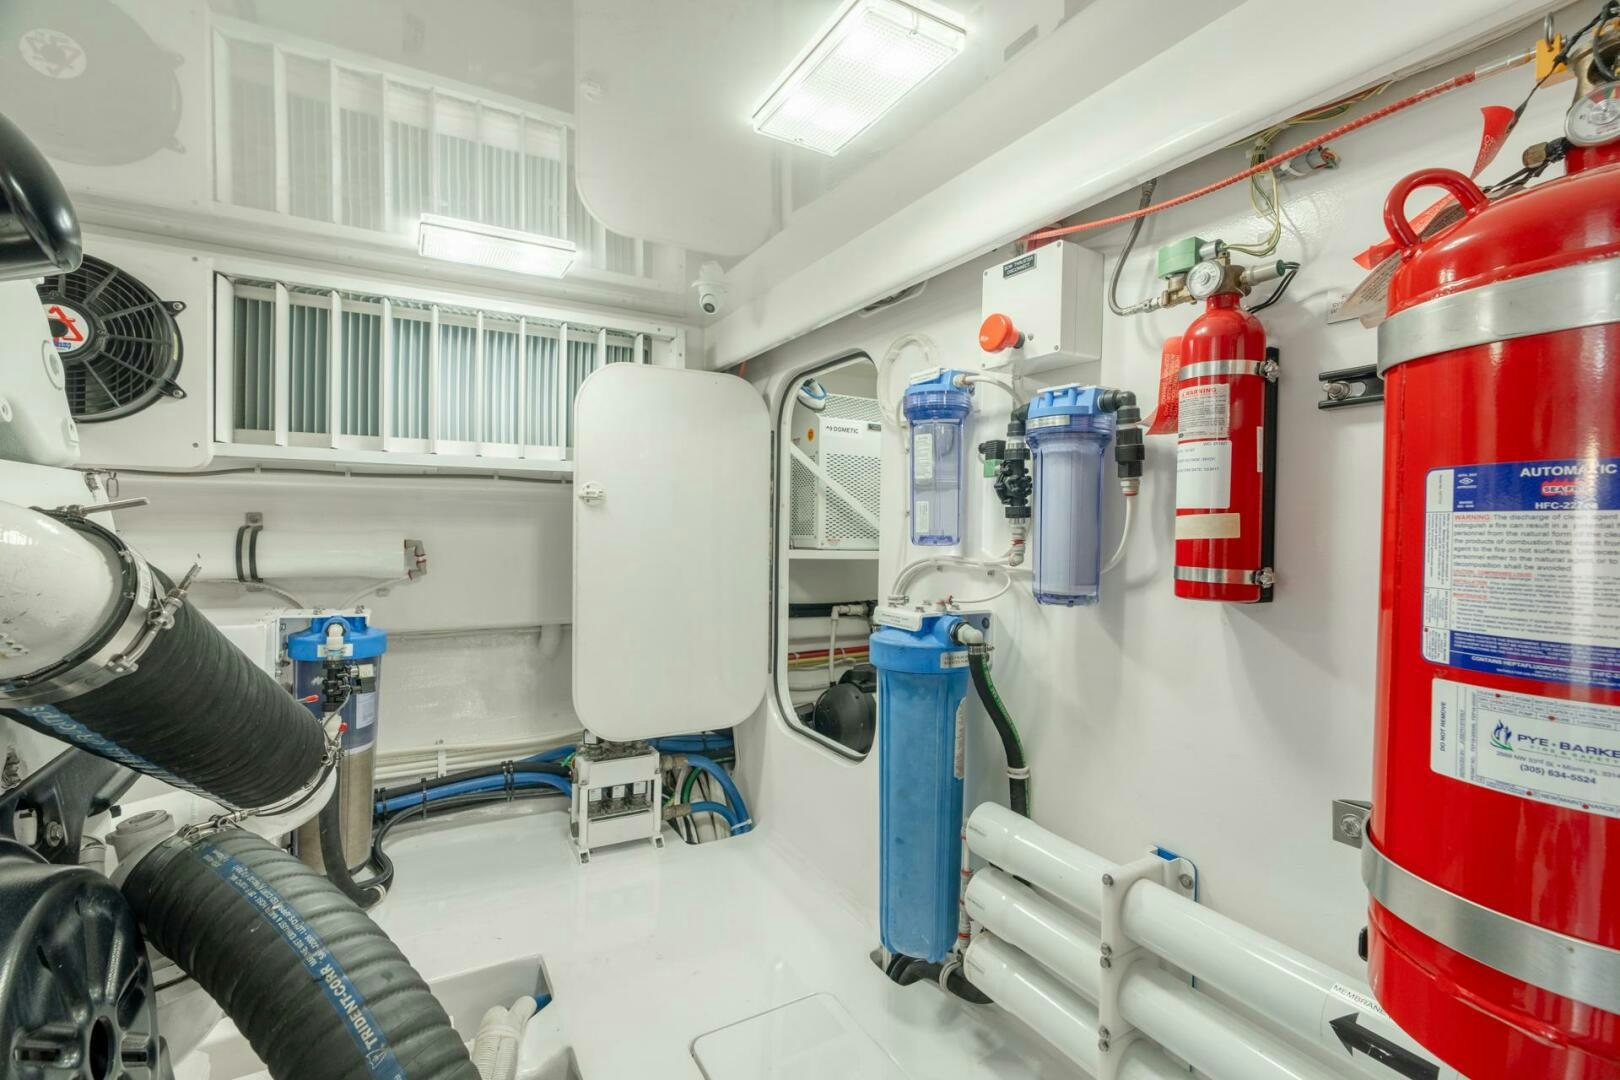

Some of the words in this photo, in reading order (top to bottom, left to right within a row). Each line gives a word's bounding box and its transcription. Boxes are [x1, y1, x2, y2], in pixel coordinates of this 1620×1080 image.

[1520, 464, 1618, 477] AUTOMAIC
[1535, 502, 1598, 510] HFC-227
[1440, 742, 1446, 752] DO
[1518, 734, 1549, 747] PYE
[1560, 742, 1620, 758] BARKE
[1520, 764, 1545, 775] (305)
[1548, 769, 1596, 784] 634-5524
[318, 963, 378, 1050] TRIDENT-CORR
